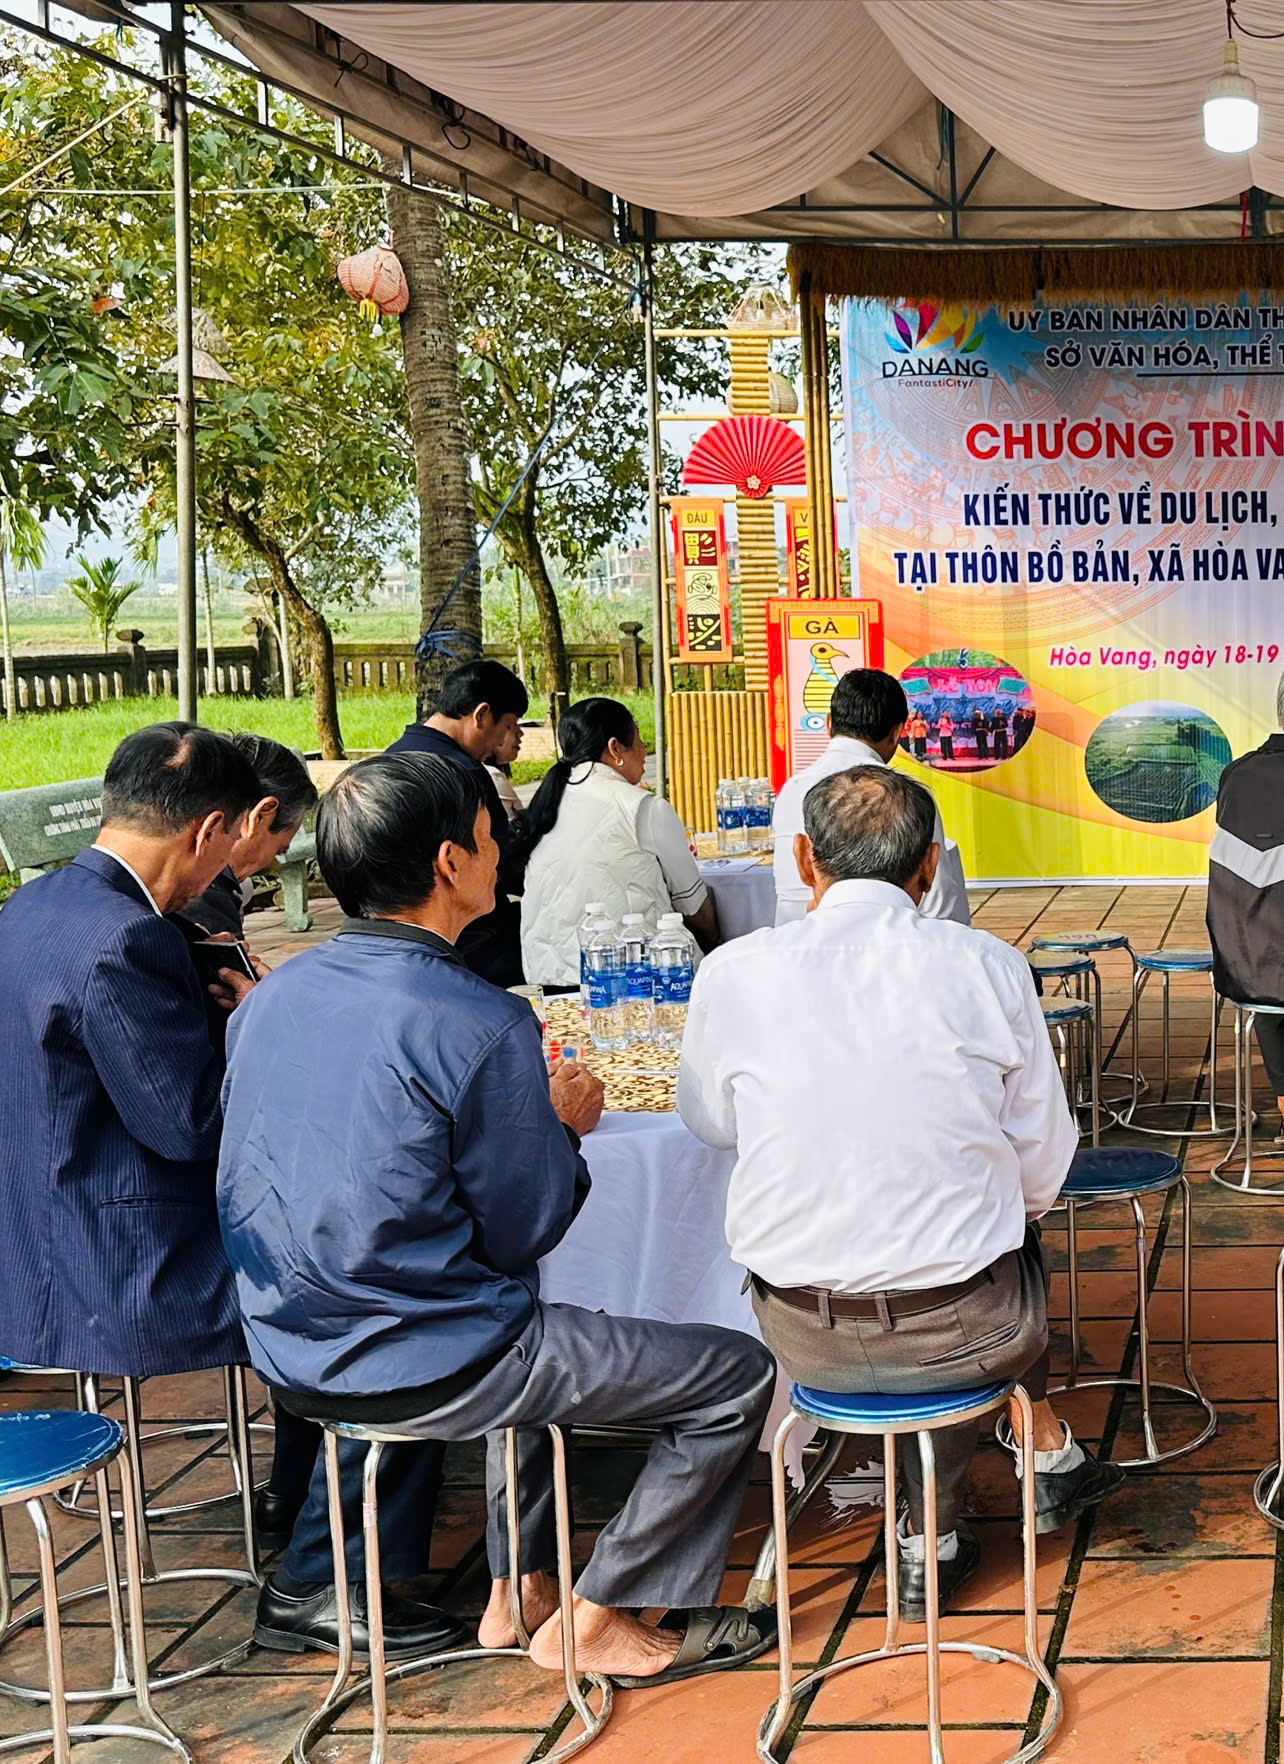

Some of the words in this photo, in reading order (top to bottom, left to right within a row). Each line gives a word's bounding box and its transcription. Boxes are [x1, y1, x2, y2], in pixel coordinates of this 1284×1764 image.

[1050, 310, 1103, 331] BAN
[1112, 304, 1187, 330] NHÂN
[1195, 303, 1250, 329] DÂN
[1046, 340, 1082, 367] SỞ
[1089, 341, 1144, 366] VĂN
[1154, 340, 1218, 369] HÓA,
[1227, 334, 1271, 365] THỂ
[882, 358, 989, 378] DANANG
[966, 417, 1174, 459] CHƯƠNG
[964, 483, 1030, 526] KIẾN
[1038, 486, 1110, 525] THỨC
[1118, 481, 1151, 524] VỀ
[1160, 491, 1196, 524] DU
[1205, 490, 1277, 531] LỊCH,
[894, 552, 937, 591] TẠI
[945, 545, 1018, 583] THÔN
[1028, 540, 1063, 583] BỒ
[1073, 539, 1139, 586] BẢN,
[1148, 543, 1185, 582] XÃ
[1193, 541, 1248, 582] HÒA
[805, 617, 839, 634] GÀ
[1050, 646, 1091, 666] Hòa
[1099, 647, 1157, 670] Vang,
[1164, 645, 1217, 669] ngày
[1224, 645, 1279, 664] 18-19
